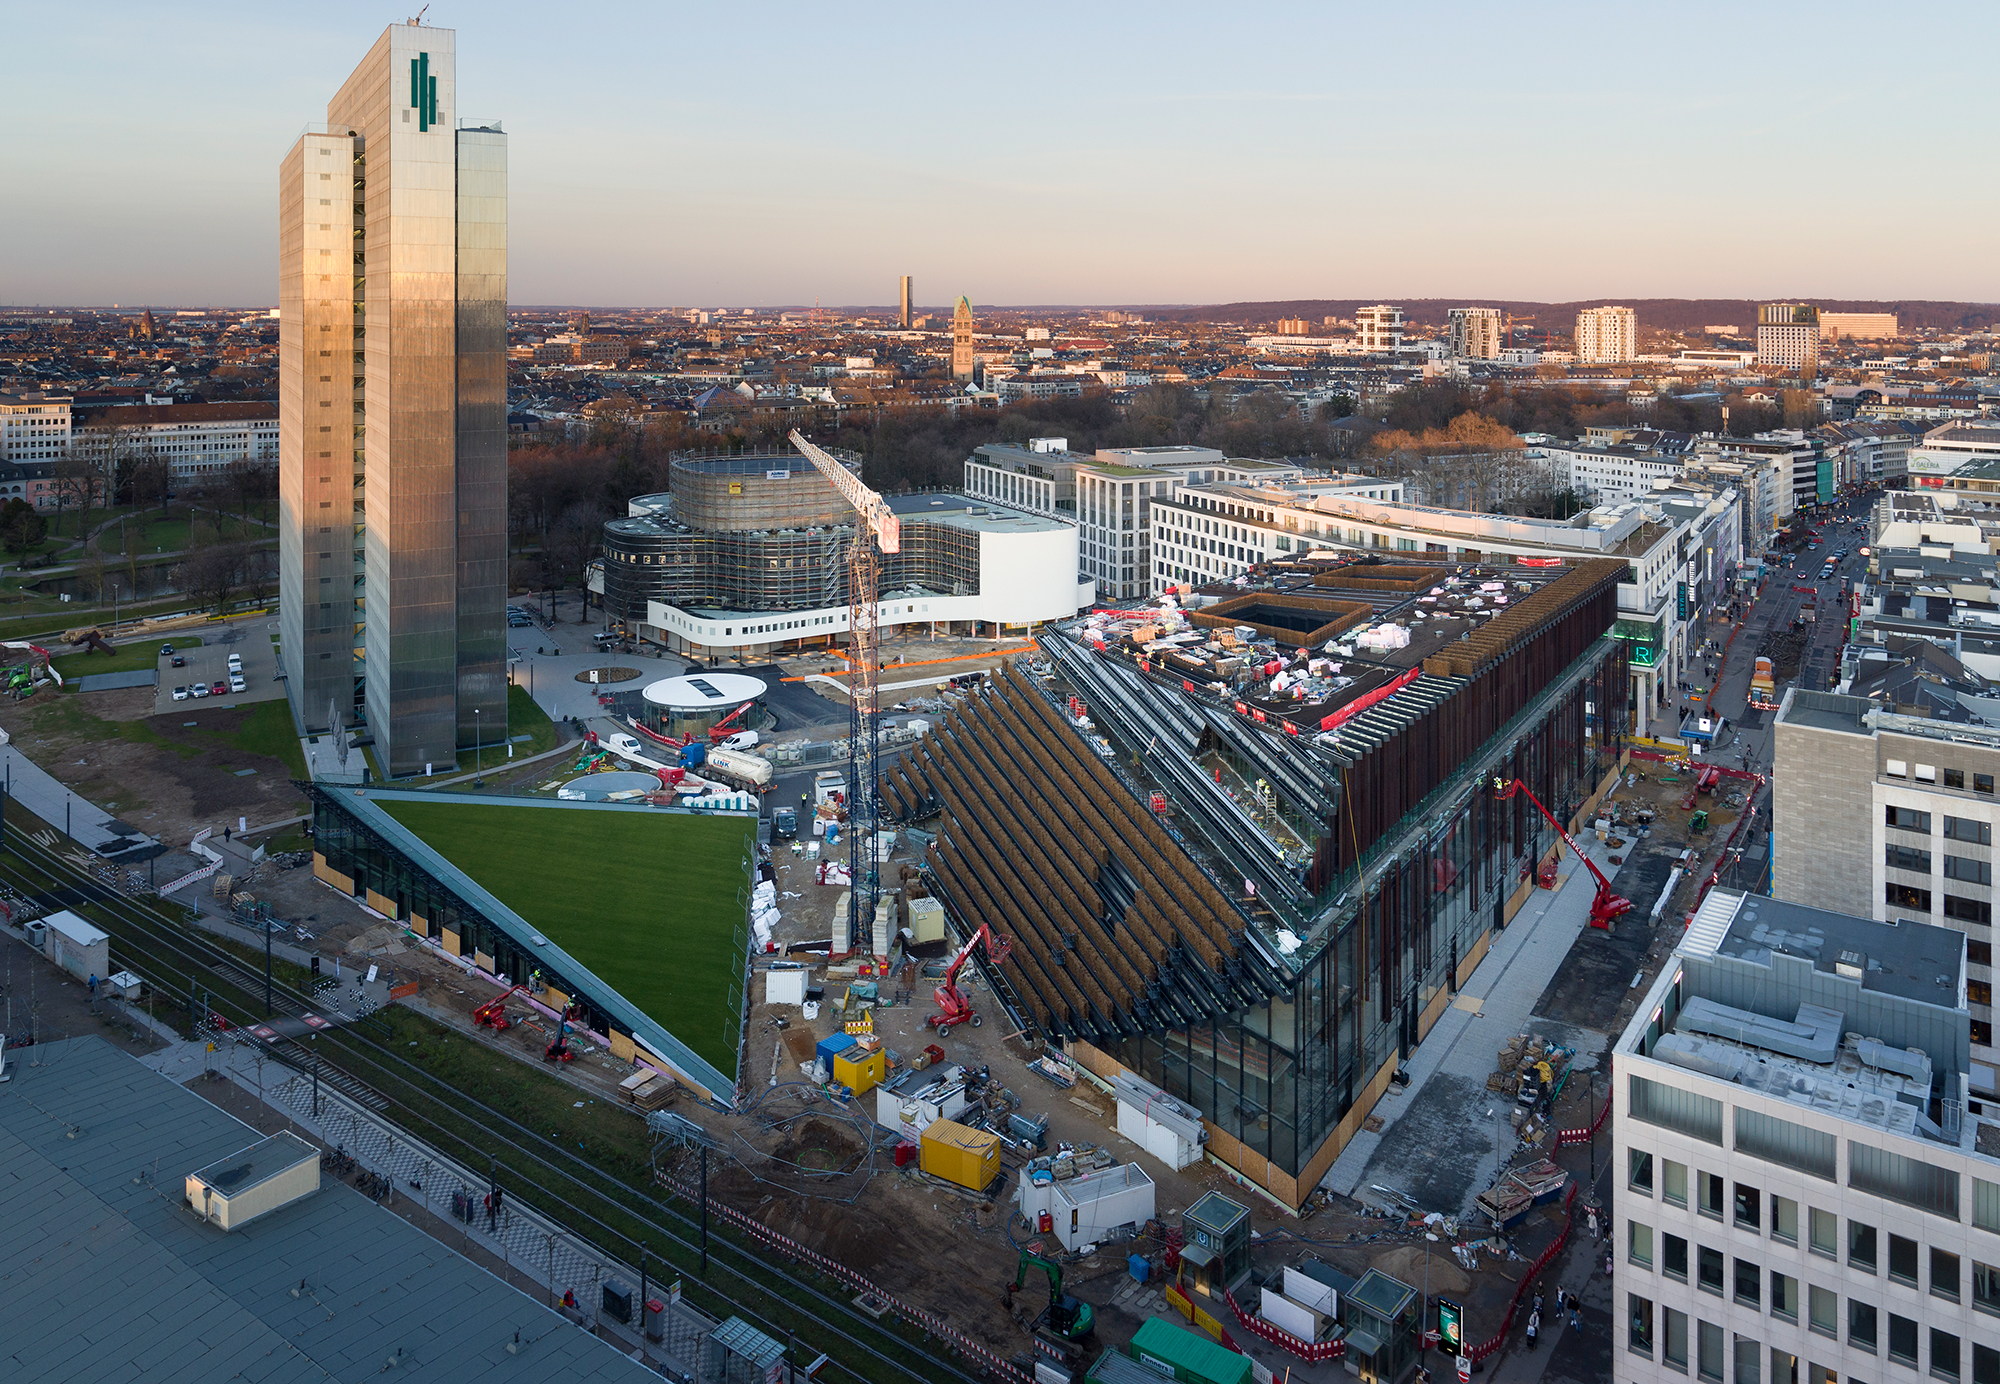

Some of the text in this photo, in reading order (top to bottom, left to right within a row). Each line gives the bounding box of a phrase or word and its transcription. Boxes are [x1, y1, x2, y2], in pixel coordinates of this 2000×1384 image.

[713, 758, 730, 768] LINK
[1564, 833, 1587, 860] GERKEN
[1141, 1354, 1169, 1372] Fenners
